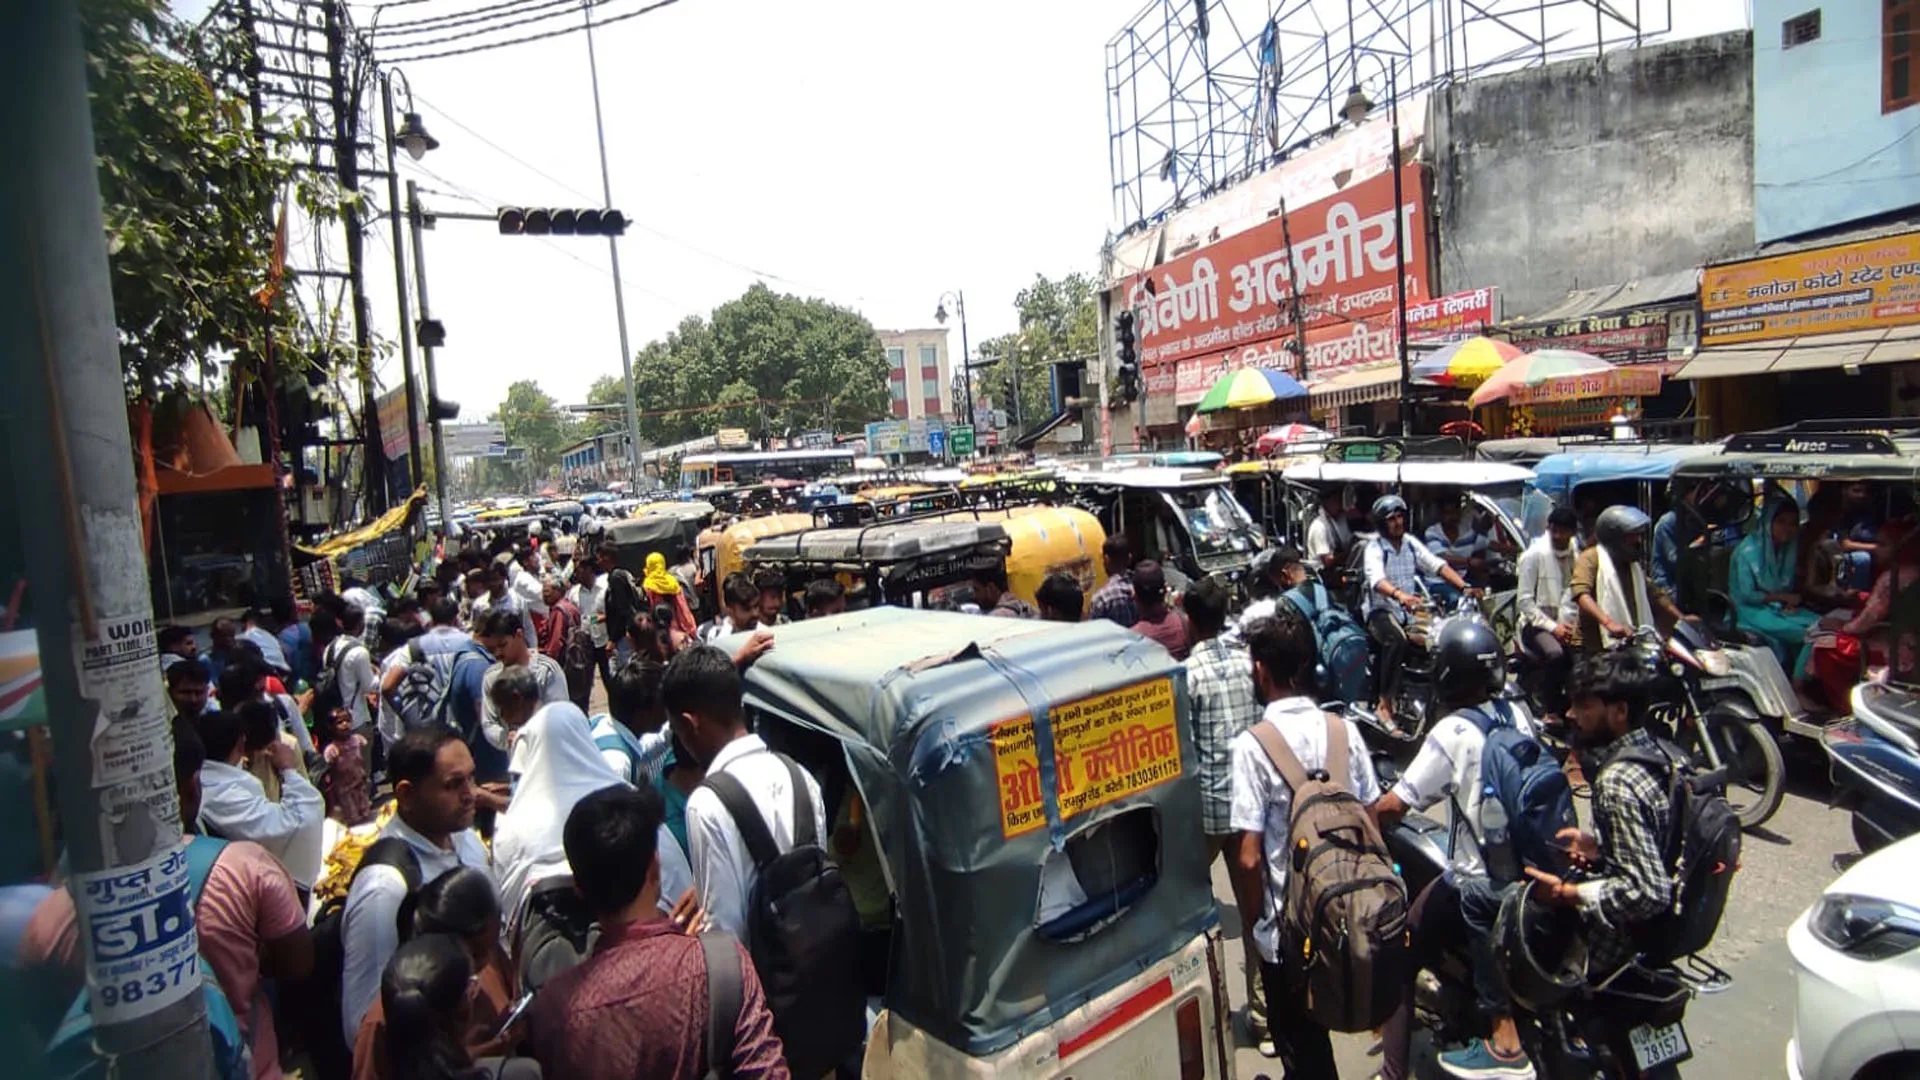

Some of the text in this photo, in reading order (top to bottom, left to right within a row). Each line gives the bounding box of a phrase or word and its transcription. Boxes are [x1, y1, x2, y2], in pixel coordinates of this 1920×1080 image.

[1127, 202, 1416, 339] त्रिवेणी अलमीरा
[1747, 279, 1797, 298] मनोज
[1803, 269, 1842, 288] फोटो
[1850, 265, 1883, 284] स्टेट
[1340, 285, 1394, 312] उपलब्ध
[1587, 315, 1623, 331] सेवा
[1305, 321, 1393, 368] अलमीरा
[1081, 724, 1175, 782] क्लीनिक
[84, 866, 153, 904] गुप्त
